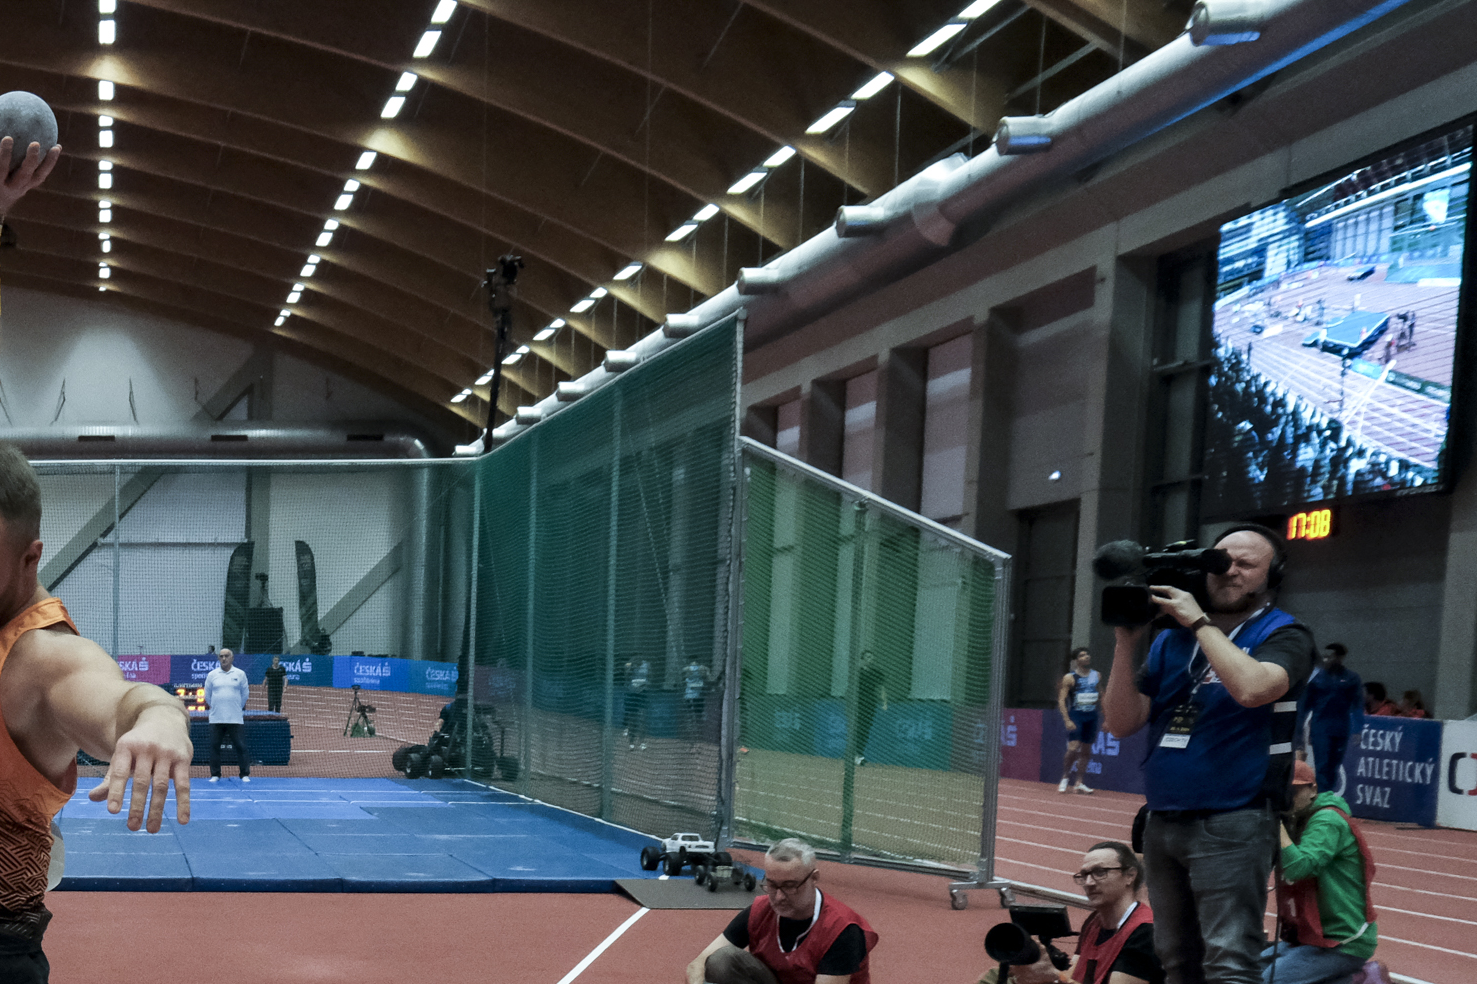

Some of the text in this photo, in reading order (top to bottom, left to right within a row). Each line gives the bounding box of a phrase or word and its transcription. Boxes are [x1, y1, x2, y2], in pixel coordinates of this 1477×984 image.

[1287, 508, 1332, 540] 17:08
[354, 661, 382, 676] ČESKÁ
[1360, 723, 1403, 753] ČESKÝ
[1356, 757, 1435, 785] ATLETICKÝ
[1355, 784, 1392, 808] SVAZ
